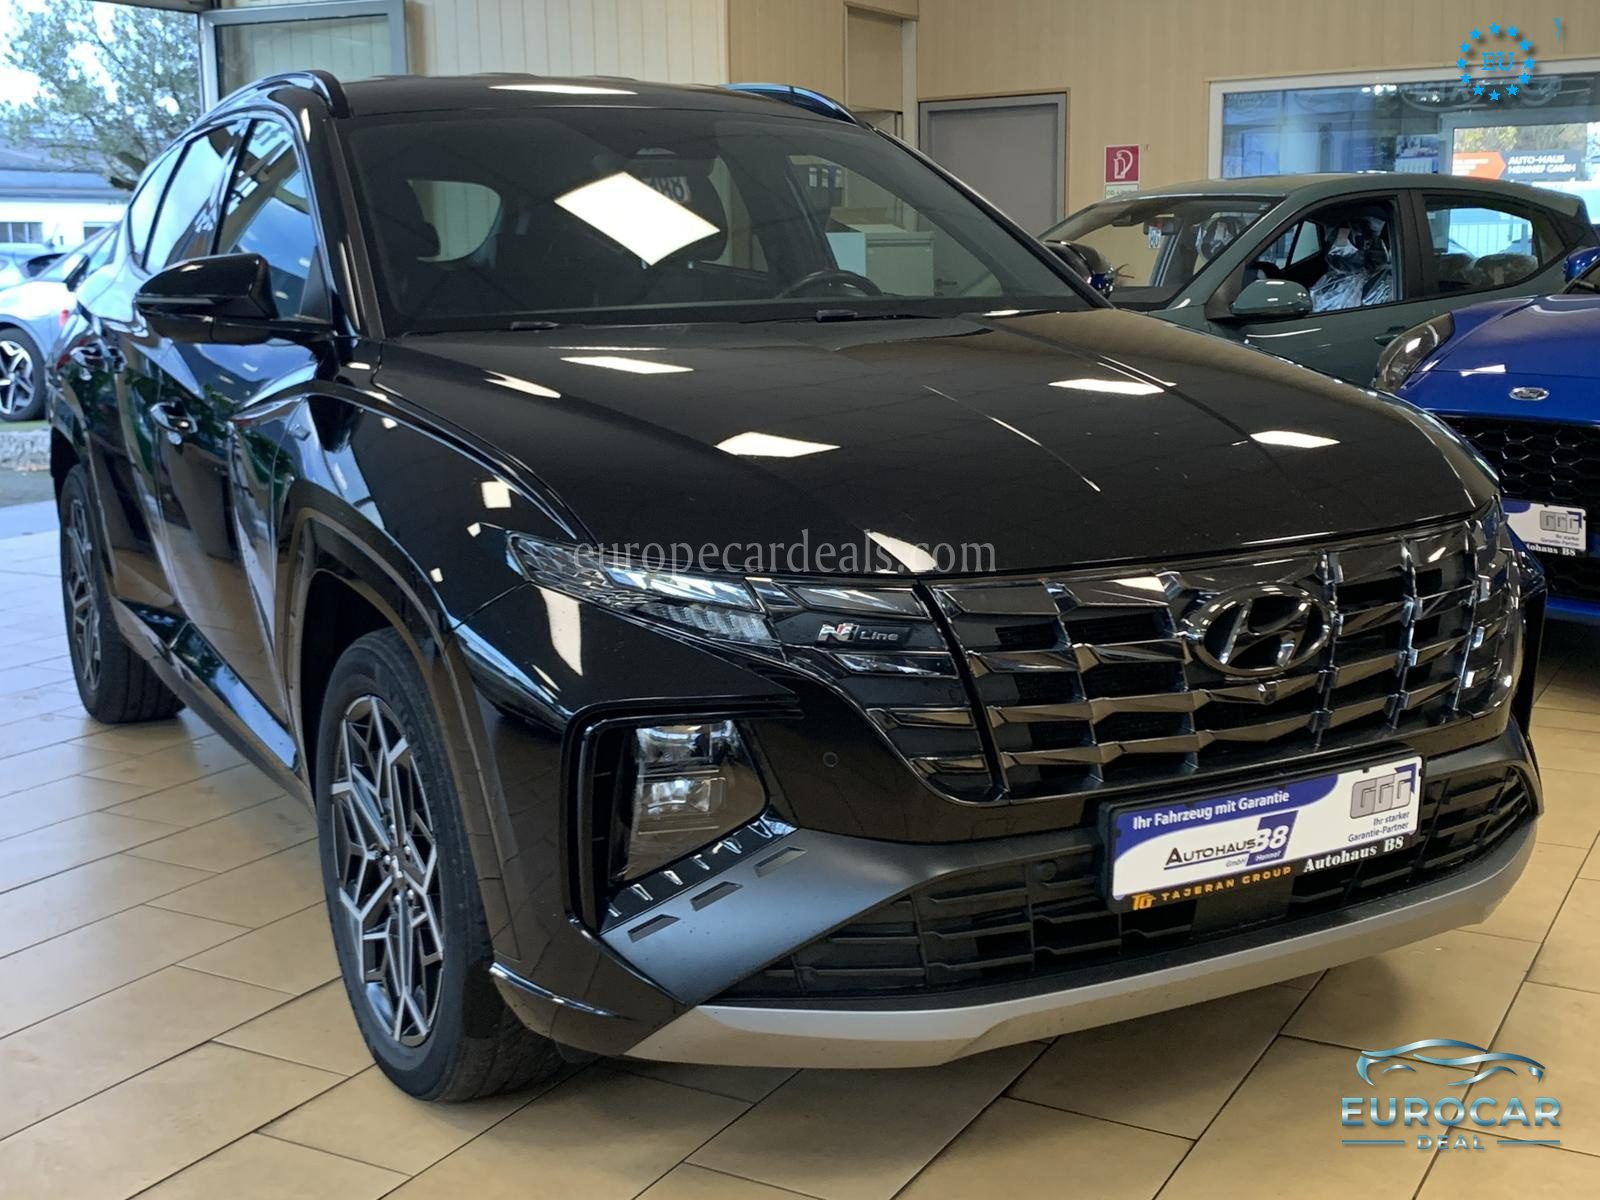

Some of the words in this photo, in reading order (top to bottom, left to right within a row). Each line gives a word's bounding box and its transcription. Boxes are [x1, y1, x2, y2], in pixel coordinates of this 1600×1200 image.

[859, 630, 899, 641] Line
[1133, 815, 1153, 830] Ihr
[1154, 806, 1213, 827] Fahrzeug
[1215, 800, 1237, 815] mit
[1238, 790, 1290, 811] Garantie
[1373, 817, 1384, 827] Ihr
[1385, 811, 1410, 823] starker
[1348, 821, 1409, 842] Garantie-Partner
[1303, 845, 1378, 873] Autohaus
[1383, 836, 1405, 853] B8
[1160, 878, 1236, 901] TAJERAN
[1241, 865, 1292, 885] GROUP
